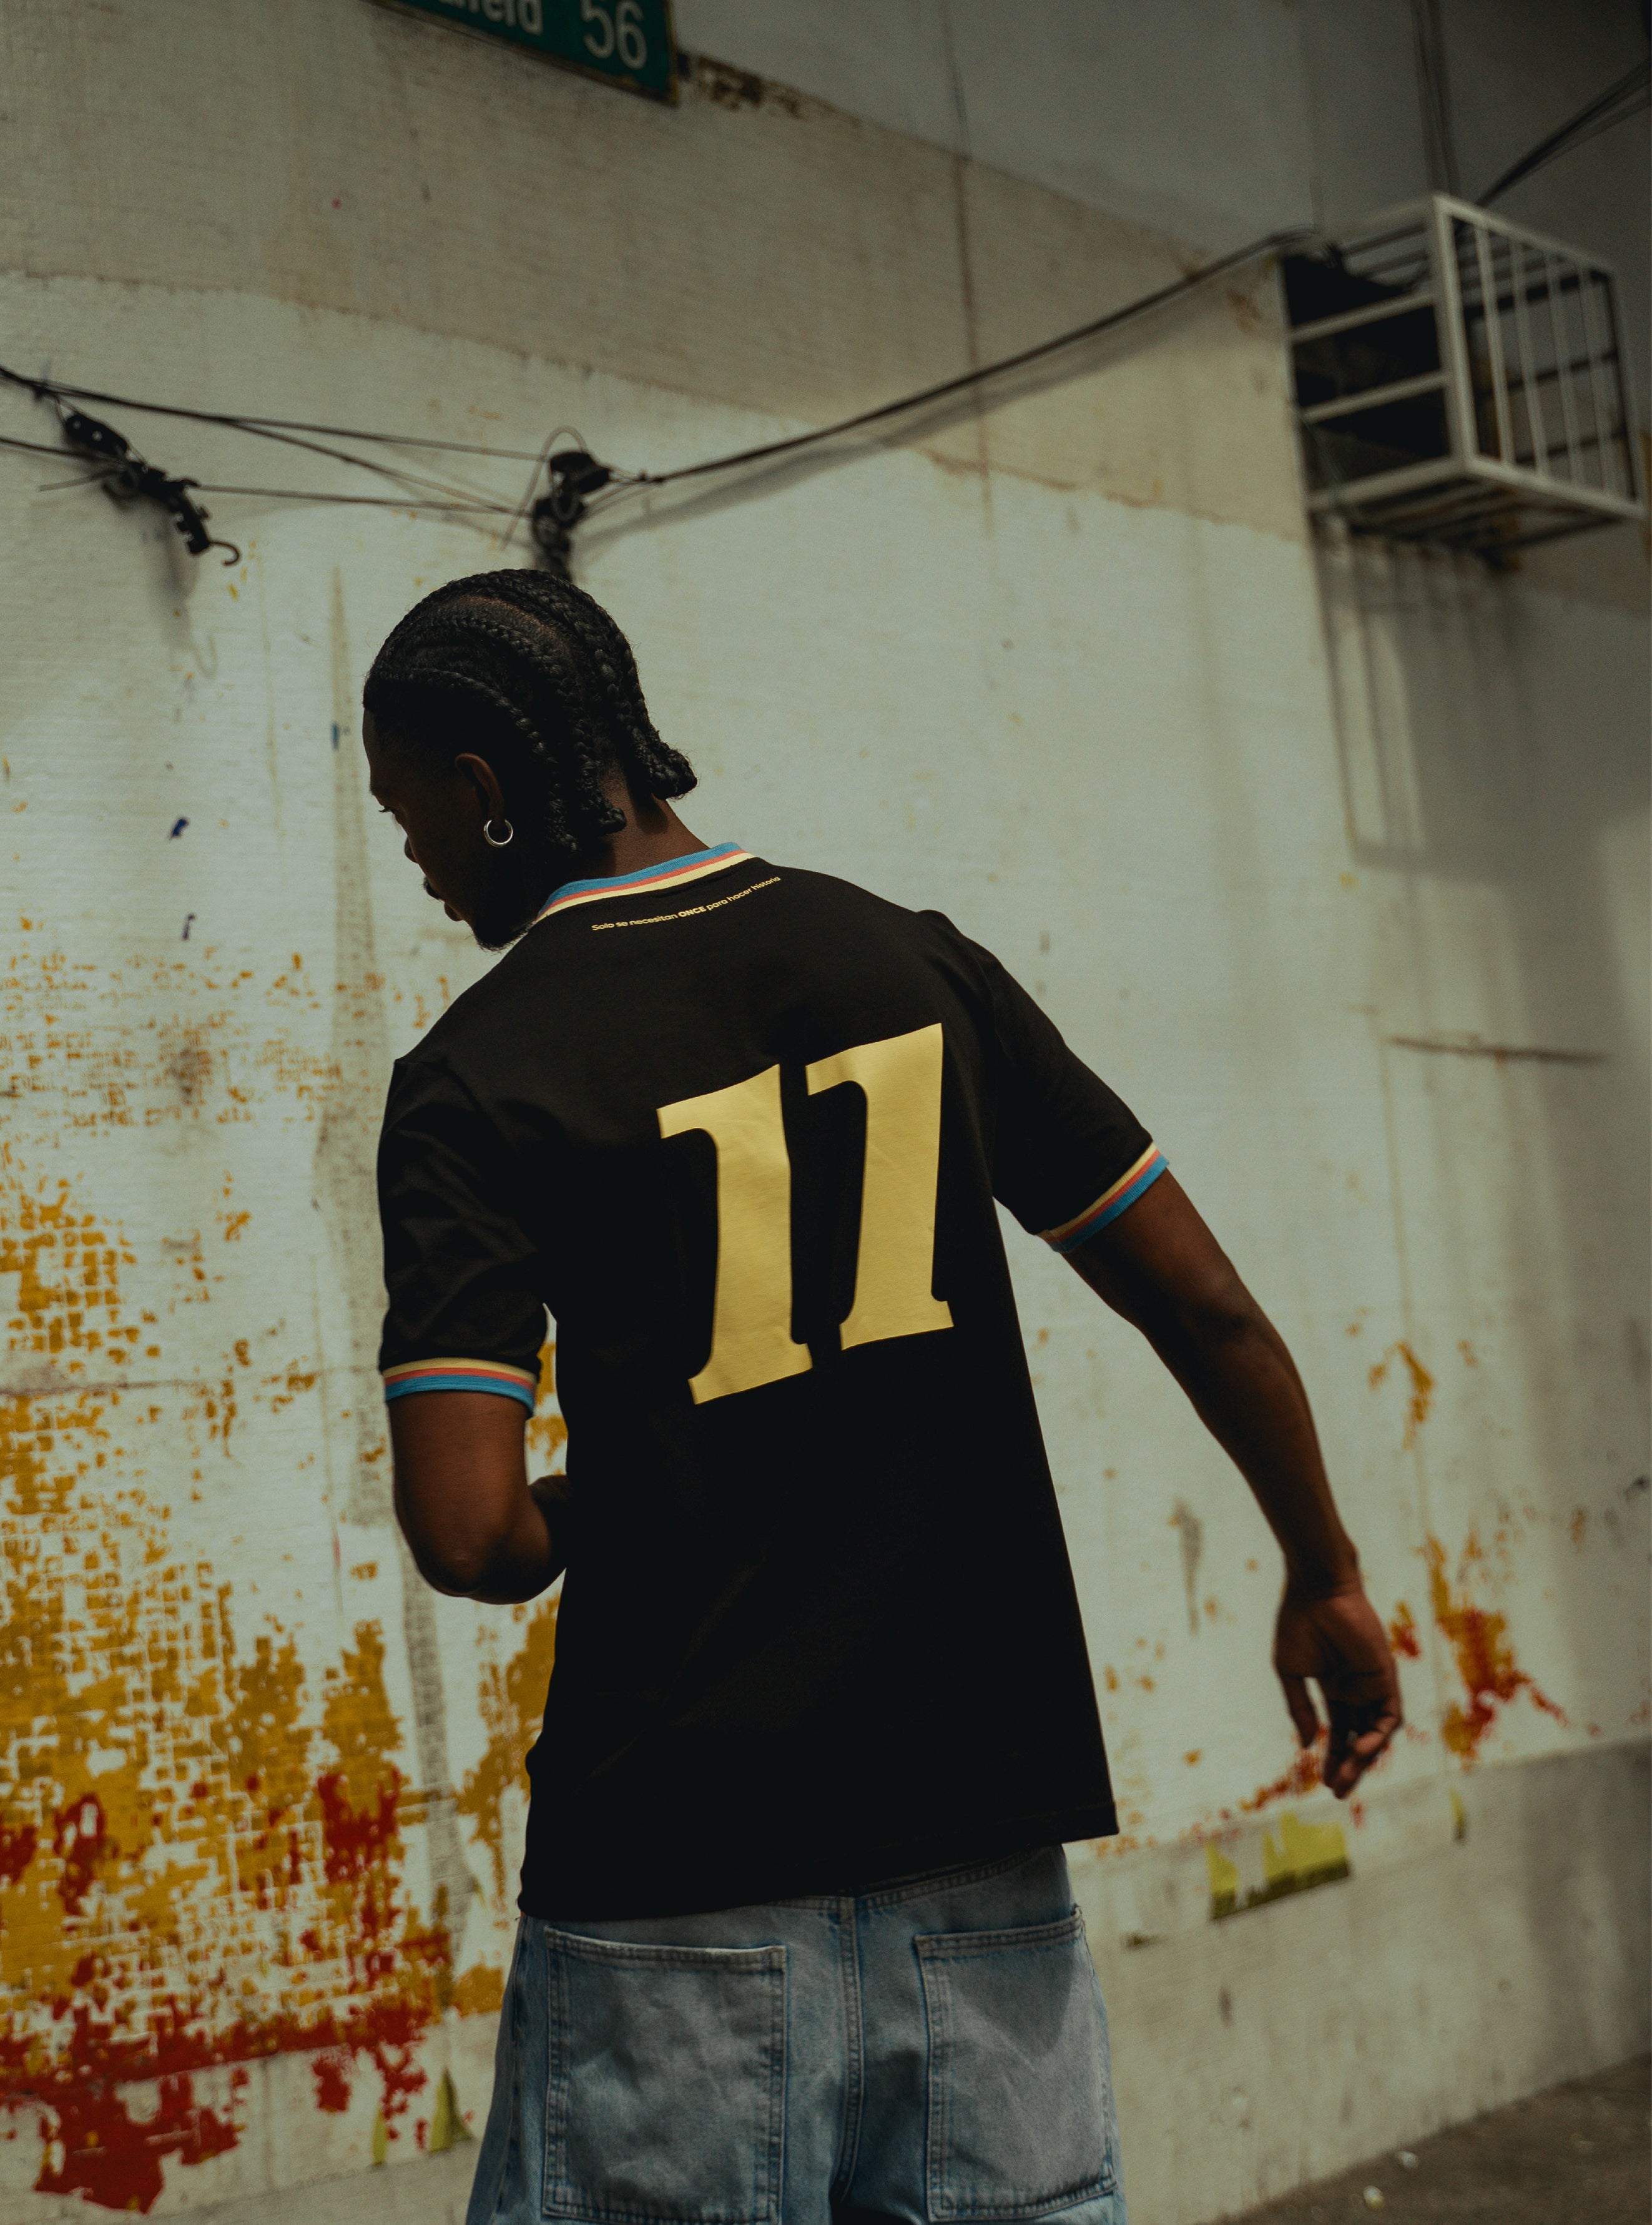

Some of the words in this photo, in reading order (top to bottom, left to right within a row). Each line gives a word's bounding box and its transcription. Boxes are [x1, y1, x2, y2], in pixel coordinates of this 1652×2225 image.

[580, 0, 647, 70] 56
[629, 914, 679, 925] necesitan
[677, 905, 707, 917] ONCE
[706, 900, 728, 911] para
[726, 888, 752, 902] hacer
[750, 876, 781, 891] historia
[656, 1023, 954, 1404] 11
